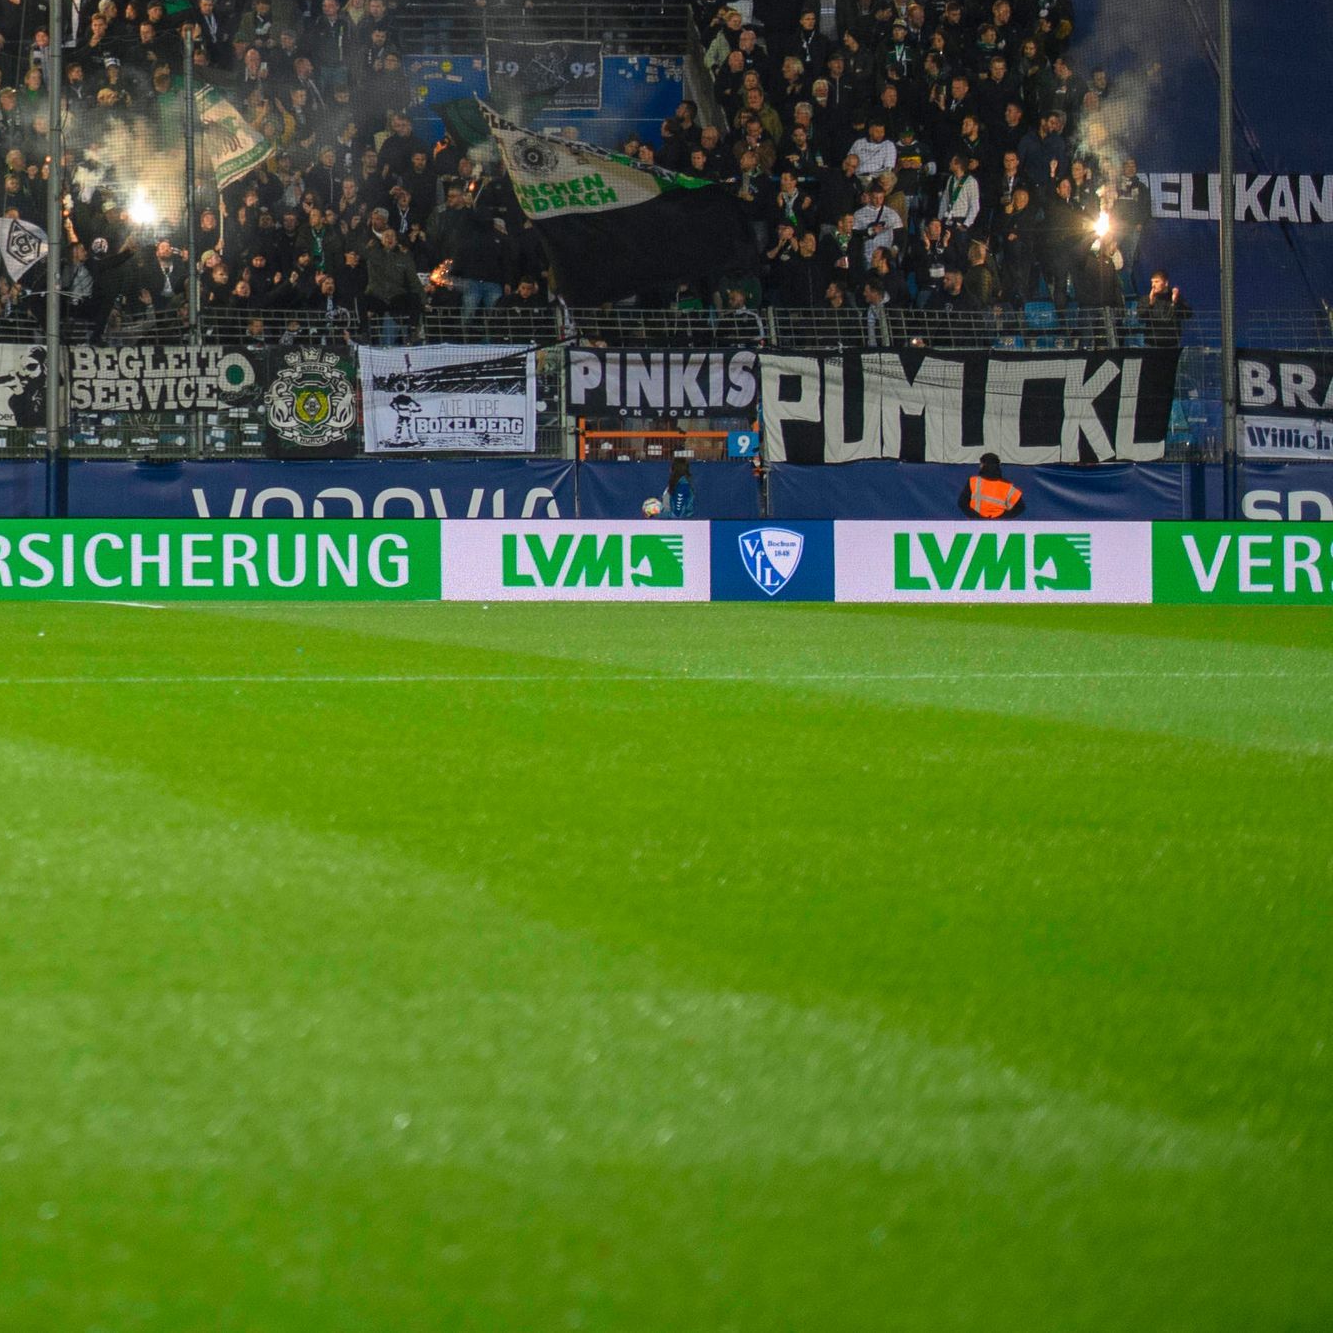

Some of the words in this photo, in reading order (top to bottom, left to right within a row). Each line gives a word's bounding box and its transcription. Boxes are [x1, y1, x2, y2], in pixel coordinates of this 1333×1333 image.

[570, 61, 596, 78] 95
[69, 345, 223, 380] BEGLEIT
[70, 377, 219, 410] SERVICE
[569, 350, 757, 408] PINKIS
[439, 399, 461, 416] ALTE
[469, 399, 500, 416] LIEBE
[619, 408, 642, 416] ON
[657, 408, 706, 417] TOUR
[737, 435, 750, 453] 9
[1245, 425, 1333, 450] Willich
[767, 540, 797, 548] Bochum
[502, 534, 624, 587] LVM
[893, 532, 1026, 590] LVM
[1181, 534, 1333, 593] VER
